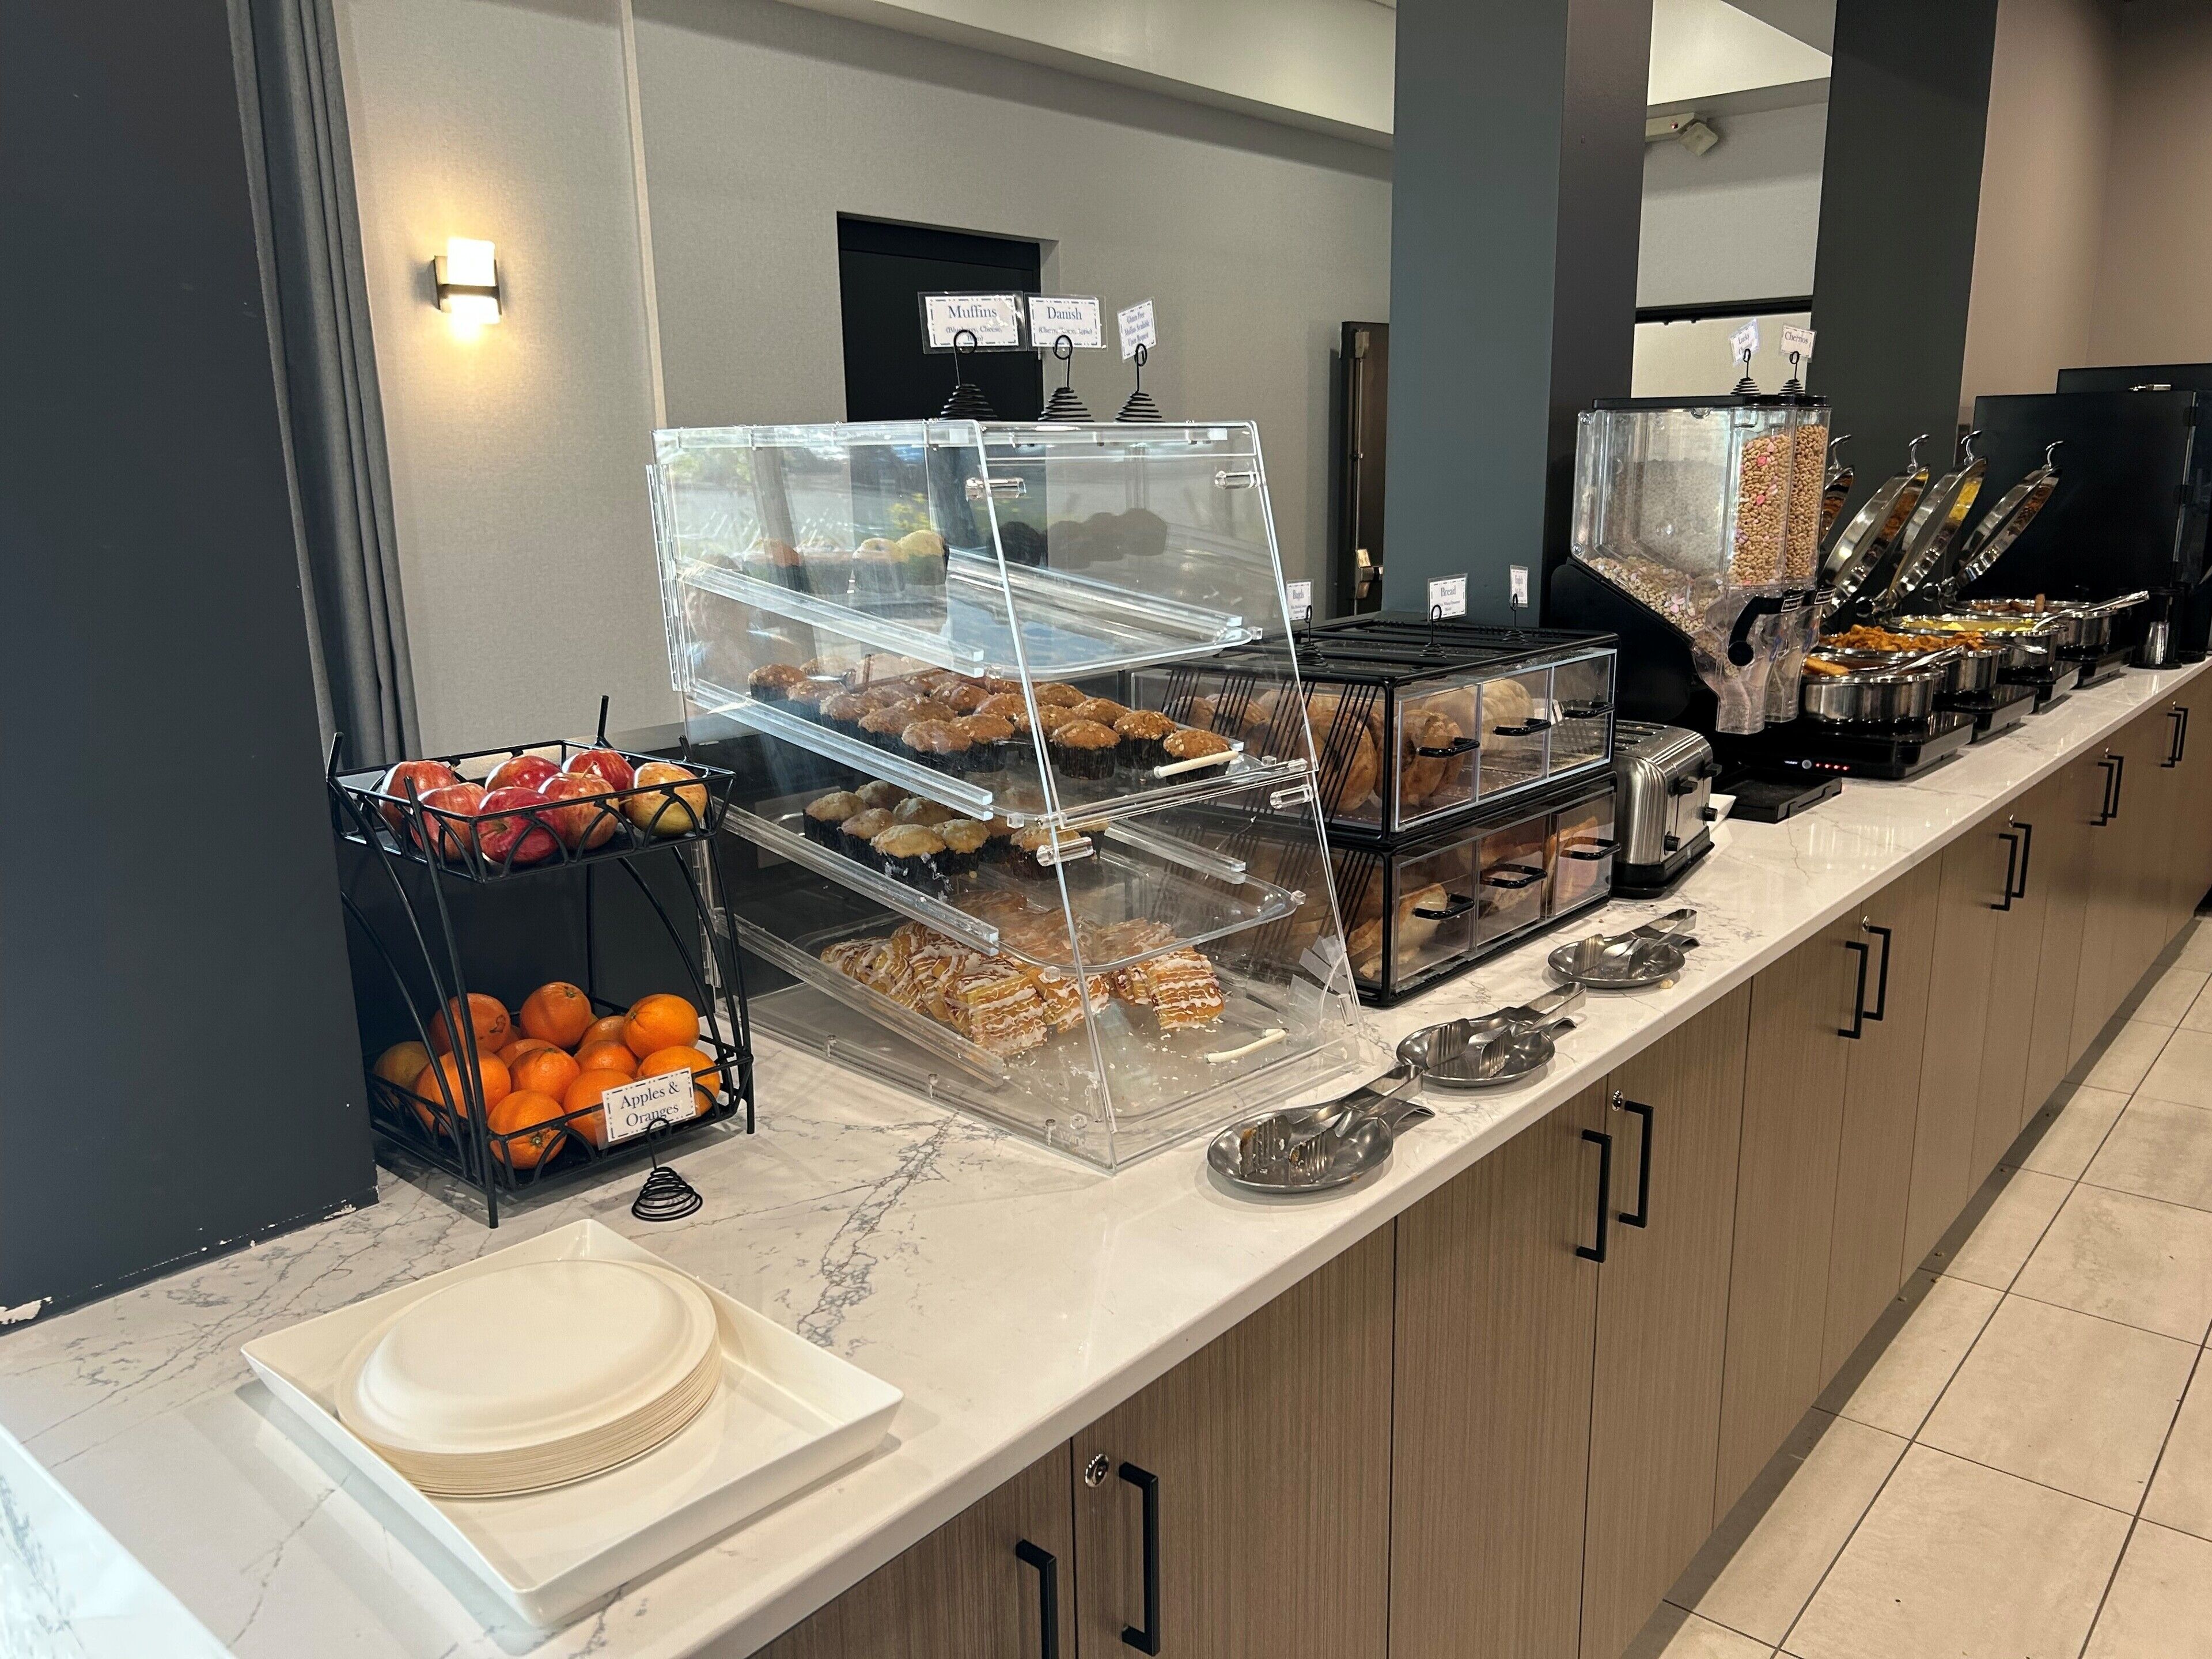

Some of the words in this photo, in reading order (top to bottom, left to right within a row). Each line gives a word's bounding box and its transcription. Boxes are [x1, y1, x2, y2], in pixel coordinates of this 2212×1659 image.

[948, 305, 997, 319] Muffins
[1047, 306, 1082, 320] Danish
[1441, 585, 1456, 596] Bread
[620, 1088, 665, 1109] Apples
[669, 1081, 680, 1094] &
[626, 1104, 679, 1127] Oranges
